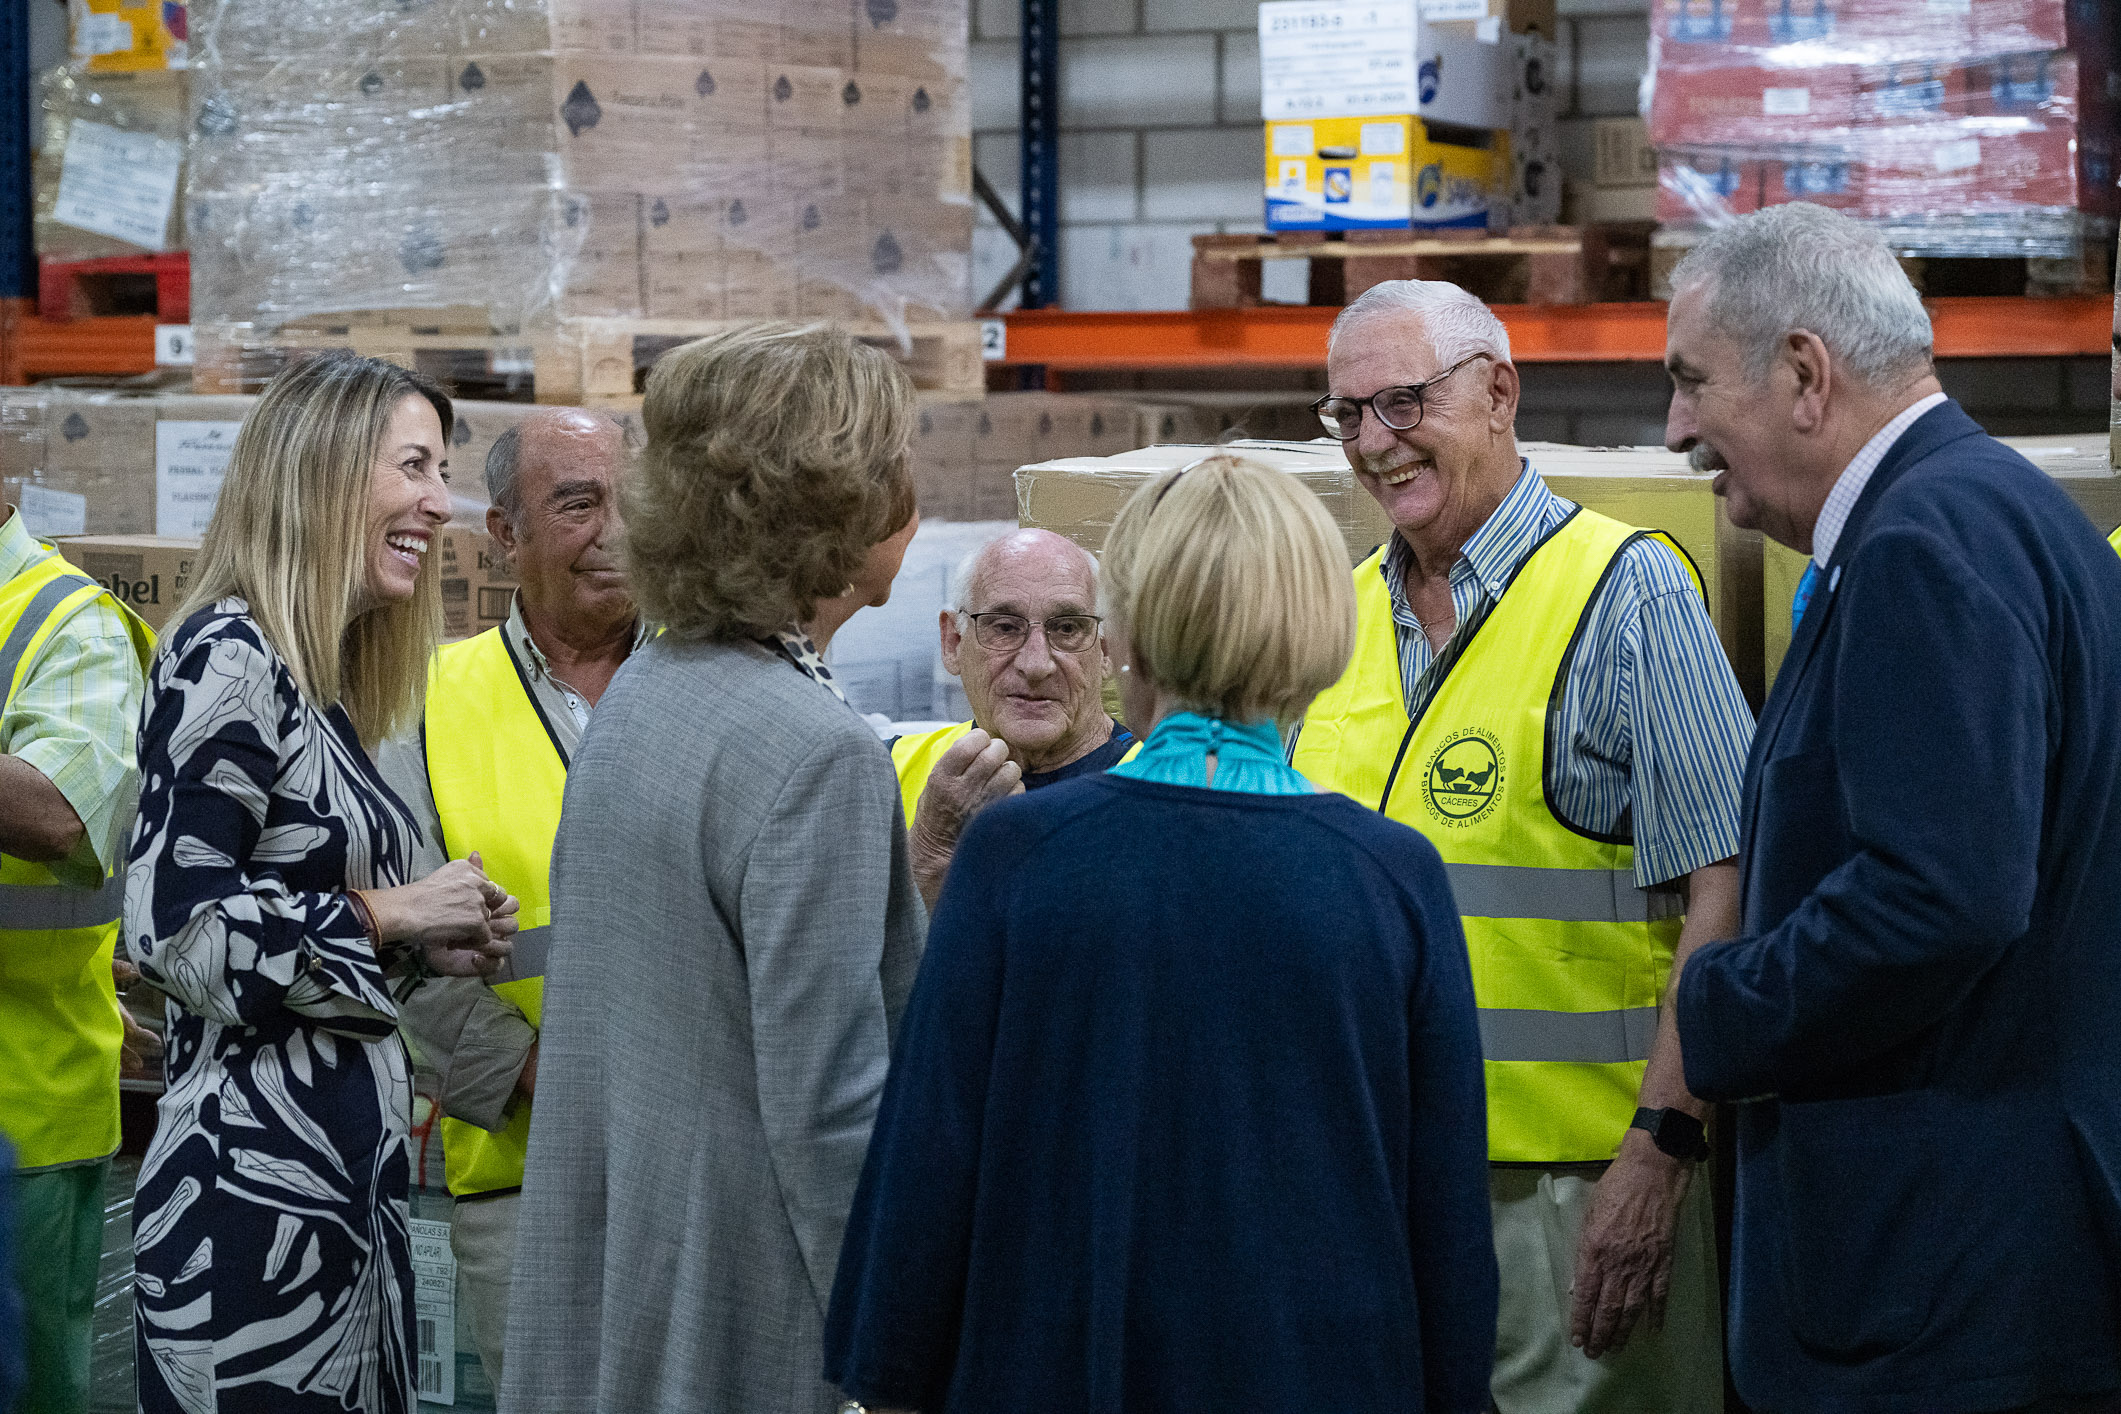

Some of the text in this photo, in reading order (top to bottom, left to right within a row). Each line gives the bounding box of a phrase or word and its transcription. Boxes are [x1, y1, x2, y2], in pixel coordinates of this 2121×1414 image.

[984, 327, 999, 348] 2
[1425, 726, 1506, 773] BANCOS DE ALIMENTOS
[1421, 780, 1505, 829] BANCOS DE ALIMENTOS
[1440, 796, 1478, 808] CÁCERES
